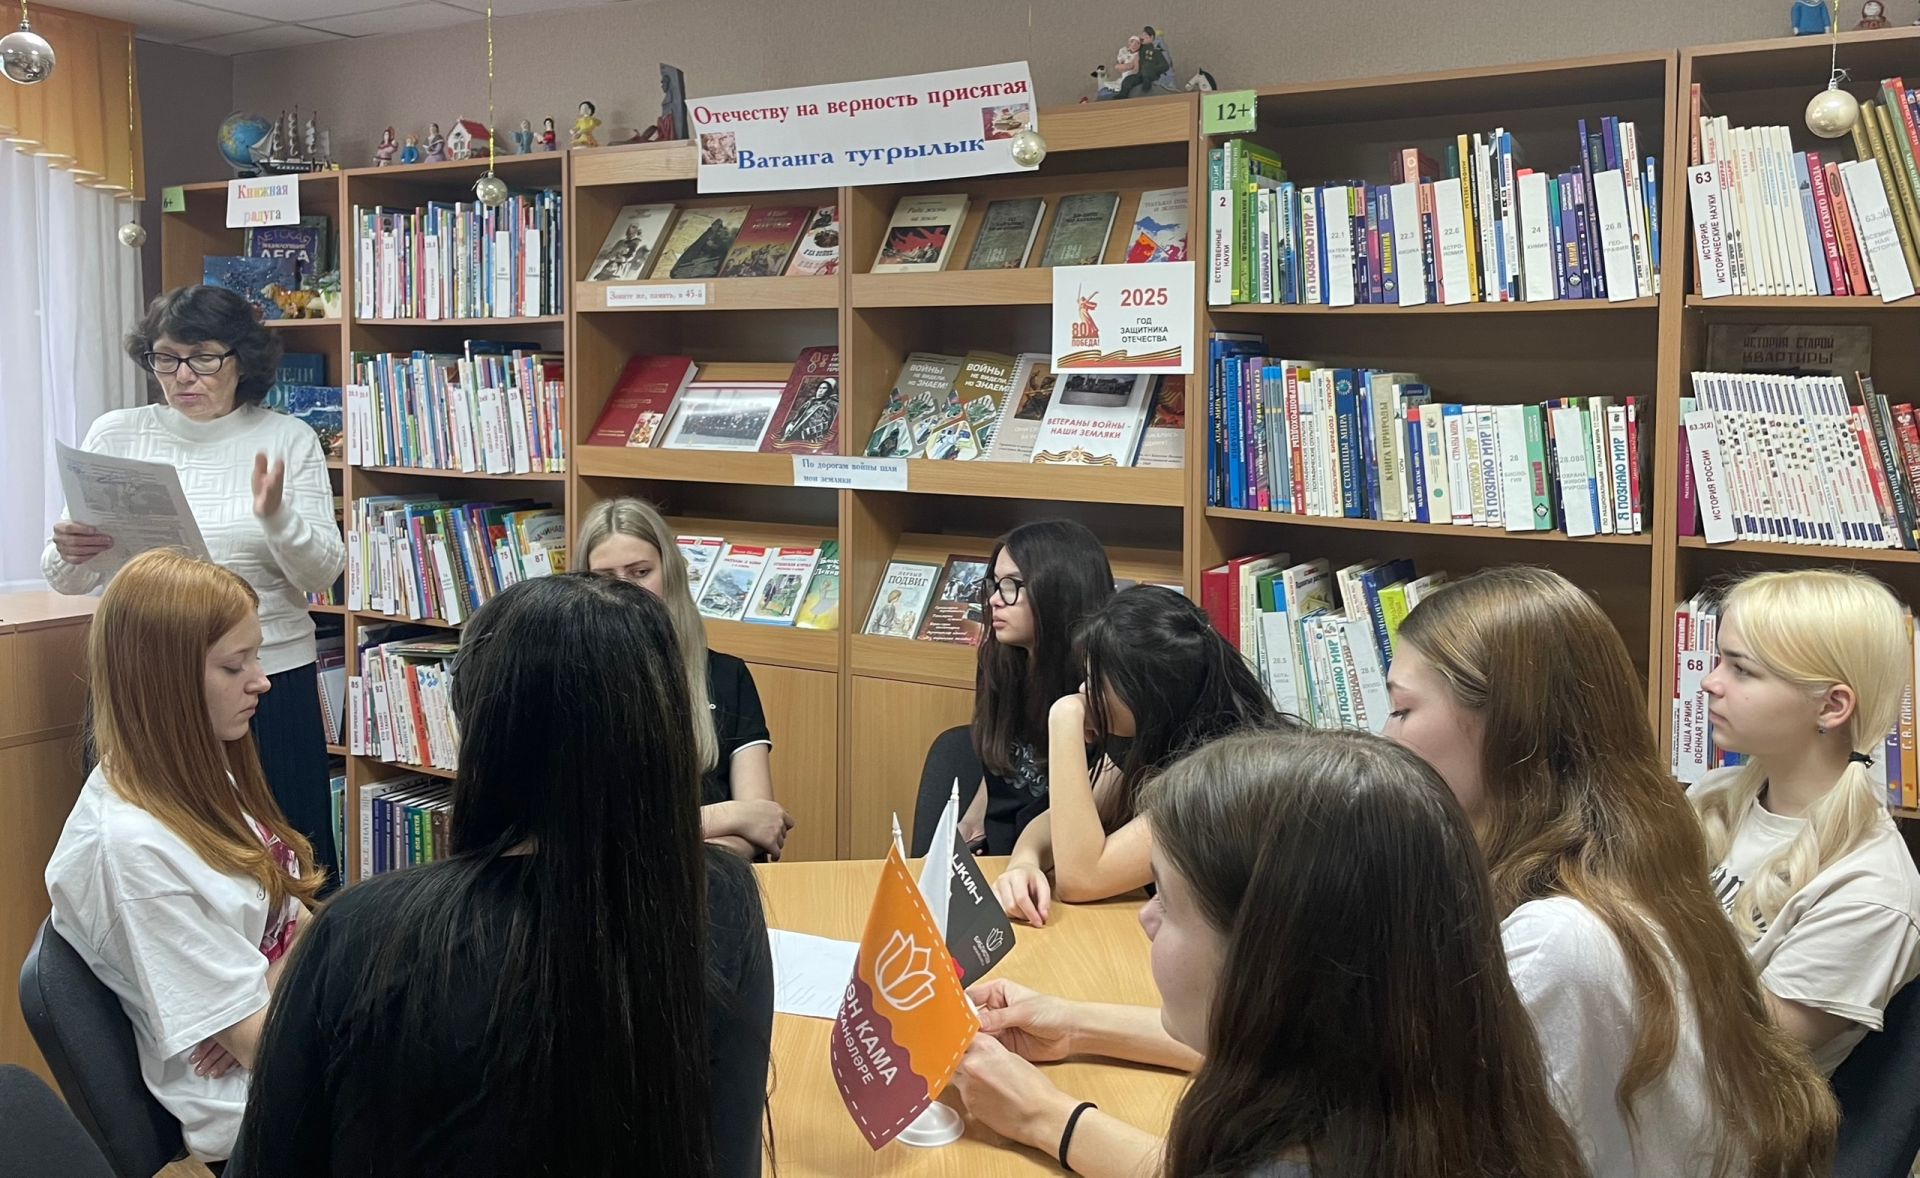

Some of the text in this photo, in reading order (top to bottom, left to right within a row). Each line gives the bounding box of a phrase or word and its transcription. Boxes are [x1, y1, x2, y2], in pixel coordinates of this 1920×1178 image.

[694, 79, 1028, 125] Отечеству на верность присягая
[1217, 102, 1250, 121] 12+
[738, 137, 985, 170] Ватанга тугрылык
[1695, 171, 1712, 184] 63
[238, 184, 288, 199] Книжная
[1219, 196, 1227, 207] 2
[244, 209, 281, 225] радуга
[1812, 165, 1838, 258] БЫТ РУССКОГО НАРОДА
[1304, 213, 1314, 236] МИР
[1444, 227, 1459, 235] 22.6
[1531, 226, 1541, 234] 24
[1605, 223, 1622, 231] 26.8
[1331, 231, 1345, 239] 22.1
[1707, 194, 1726, 284] ИСТОРИЧЕСКИЕ НАУКИ
[1837, 200, 1860, 276] ИСТОРИЯ ОТЕЧЕСТВА
[1305, 238, 1316, 283] ПОЗНАЮ
[1120, 287, 1169, 307] 2025
[1136, 317, 1152, 326] ГОД
[1071, 322, 1088, 337] 80
[1120, 325, 1169, 335] ЗАЩИТНИКА
[1071, 338, 1100, 347] ПОБЕДА!
[1121, 335, 1168, 343] ОТЕЧЕСТВА
[1744, 336, 1834, 349] ИСТОРИЯ СТАРОЙ
[1742, 352, 1834, 365] КВАРТИРЫ
[909, 363, 944, 374] ВОЙНЫ
[966, 362, 1005, 377] ВОЙНЫ
[970, 372, 983, 380] НЕ
[1288, 379, 1299, 448] ПЕРВОПРОХОДЦЫ
[1047, 418, 1126, 429] ВЕТЕРАНЫ ВОЙНЫ
[1689, 421, 1714, 431] 63.3(2)
[1050, 427, 1078, 436] НАШИ
[1079, 429, 1122, 439] ЗЕМЛЯКИ
[1449, 419, 1461, 461] СТРАНЫ МИРА
[1379, 402, 1393, 481] КНИГА ПРИРОДЫ
[802, 458, 897, 473] По дорогам войны шли
[1339, 414, 1352, 508] ВСЕ СТОЛИЦЫ МИРА
[1509, 454, 1519, 462] 28
[820, 476, 852, 484] земляки
[1466, 437, 1484, 515] Я ПОЗНАЮ МИР
[1480, 431, 1498, 518] Я ПОЗНАЮ МИР
[1561, 472, 1586, 480] ОХРАНА
[1612, 437, 1629, 520] Я ПОЗНАЮ МИР
[1879, 439, 1905, 514] ЦАРСКИЕ ДИНАСТИИ
[1701, 449, 1722, 520] ИСТОРИЯ РОССИИ
[1599, 471, 1607, 517] НАЦИОНАЛЬНЫМ
[1603, 517, 1608, 526] ПО
[534, 553, 544, 563] 87
[888, 576, 928, 587] ПОДВИГ
[1383, 638, 1393, 662] МИРА
[1687, 659, 1703, 672] 68
[1327, 640, 1351, 723] Я ПОЗНАЮ МИР
[1349, 668, 1364, 711] ПОЗНАЮ
[1357, 713, 1367, 721] Я
[1683, 698, 1692, 753] НАША АРМИЯ.
[1695, 690, 1704, 764] ВОЕННАЯ ТЕХНИКА
[1902, 727, 1912, 750] Г. А.
[855, 1019, 899, 1086] КАМА
